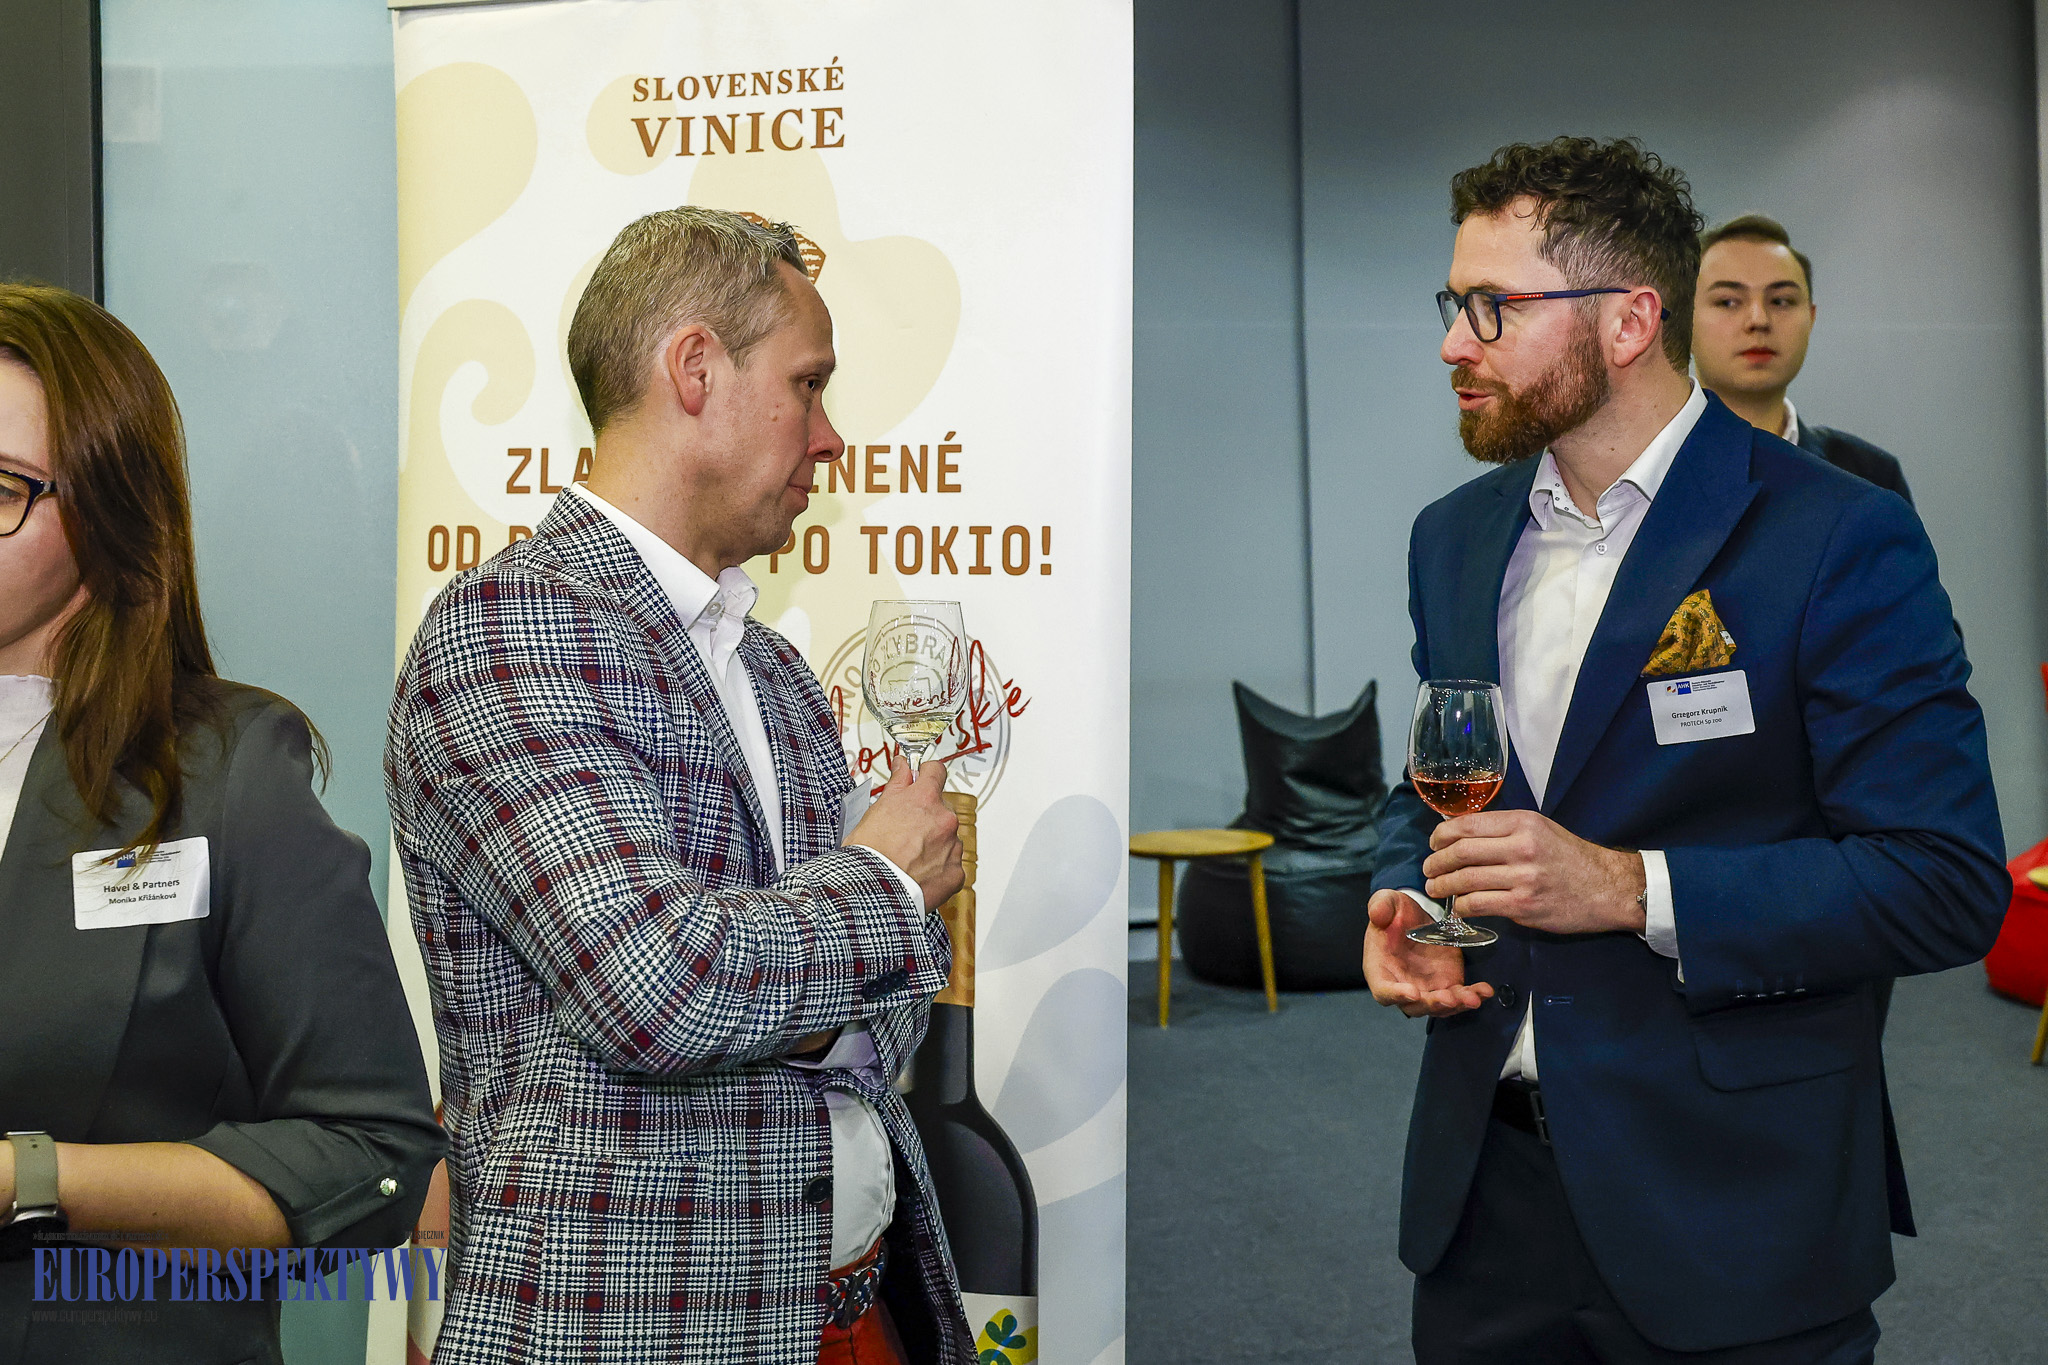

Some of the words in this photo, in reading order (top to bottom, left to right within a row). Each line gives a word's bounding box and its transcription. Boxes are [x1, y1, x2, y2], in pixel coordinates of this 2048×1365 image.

[632, 56, 846, 102] SLOVENSKÉ
[631, 107, 847, 158] VINICE
[505, 447, 596, 494] ZLA
[809, 431, 963, 494] NENÉ
[427, 524, 482, 572] OD
[769, 525, 830, 575] PO
[860, 525, 1052, 576] TOKIO!
[1671, 710, 1700, 720] Grzegorz
[1701, 705, 1728, 715] Krupnik
[103, 883, 130, 894] Havel
[132, 881, 141, 891] &
[142, 880, 180, 889] Partners
[108, 896, 137, 905] Monika
